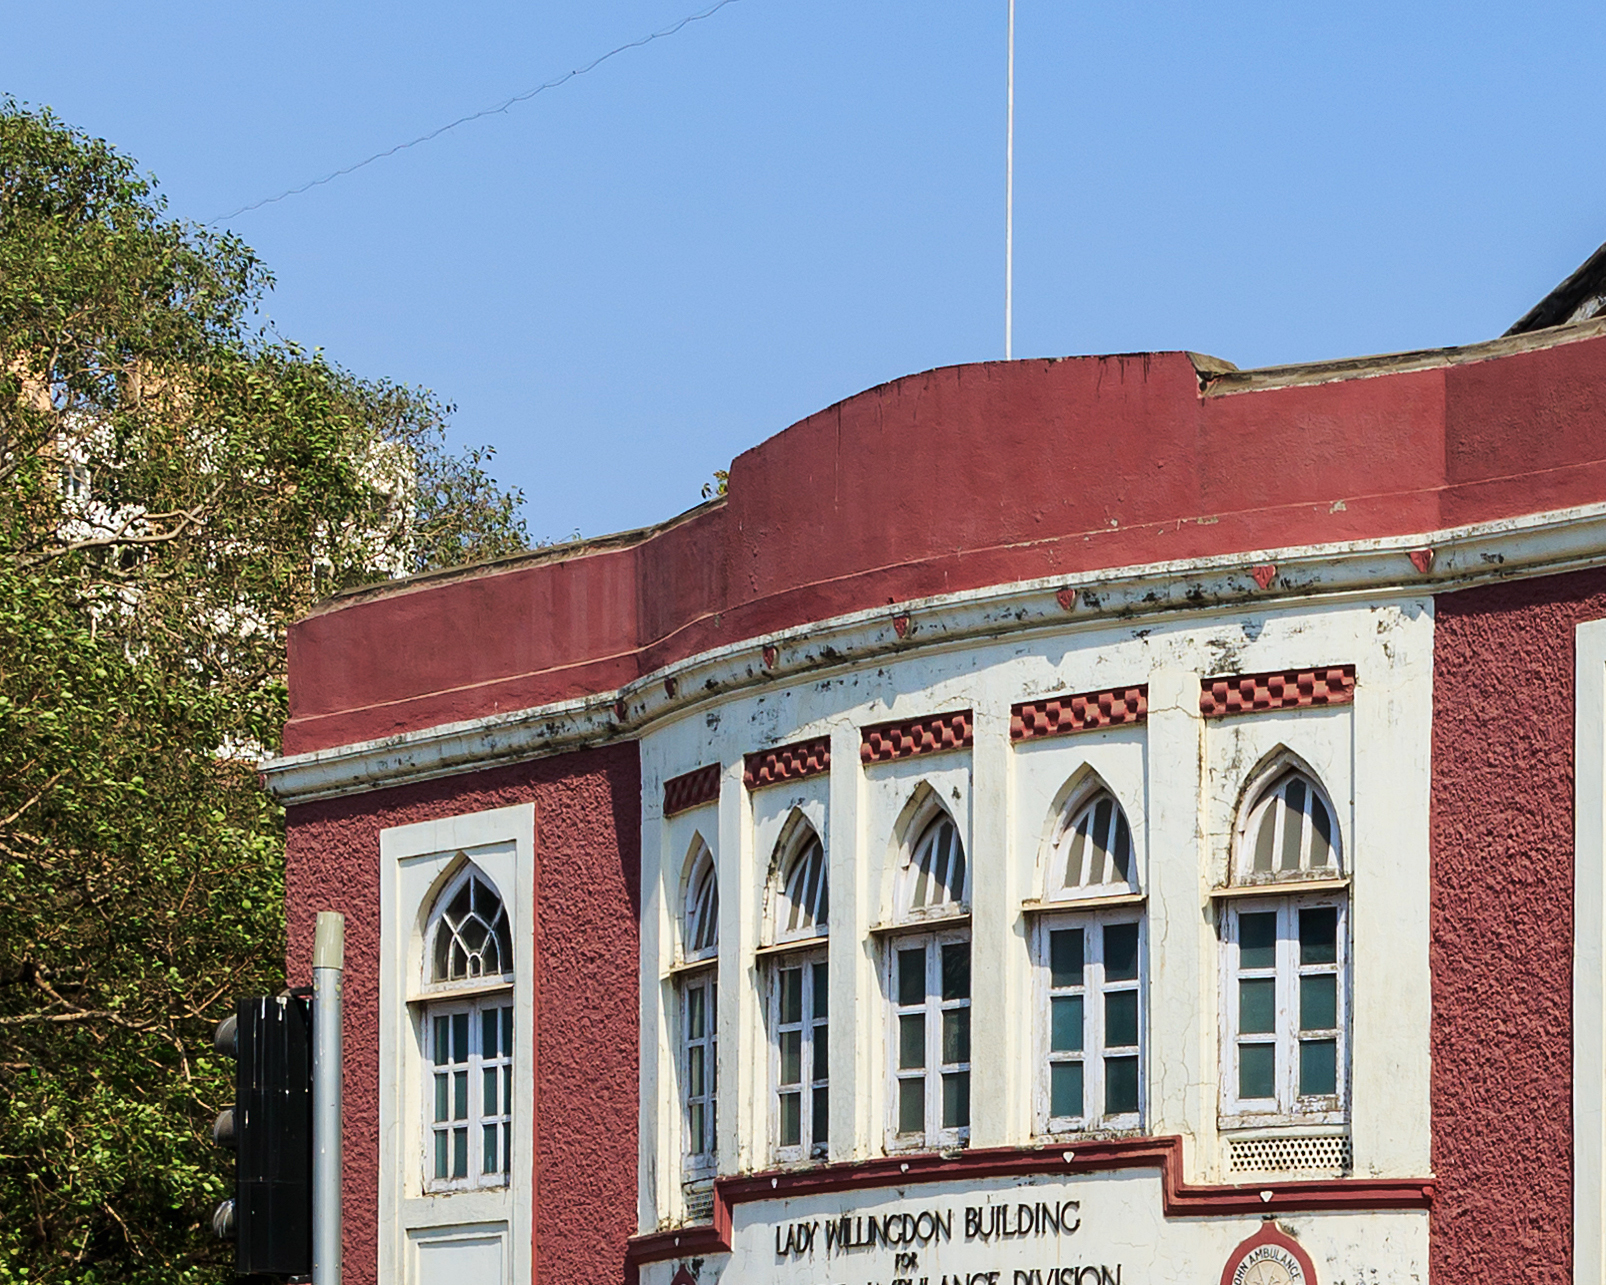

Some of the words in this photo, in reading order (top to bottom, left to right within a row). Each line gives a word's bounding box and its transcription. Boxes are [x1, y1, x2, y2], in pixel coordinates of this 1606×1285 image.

[776, 1221, 818, 1256] LADY
[826, 1209, 951, 1251] WILLINGDON
[965, 1200, 1080, 1239] BUILDING
[895, 1252, 918, 1270] FOR
[1248, 1247, 1302, 1282] AMBULANCE
